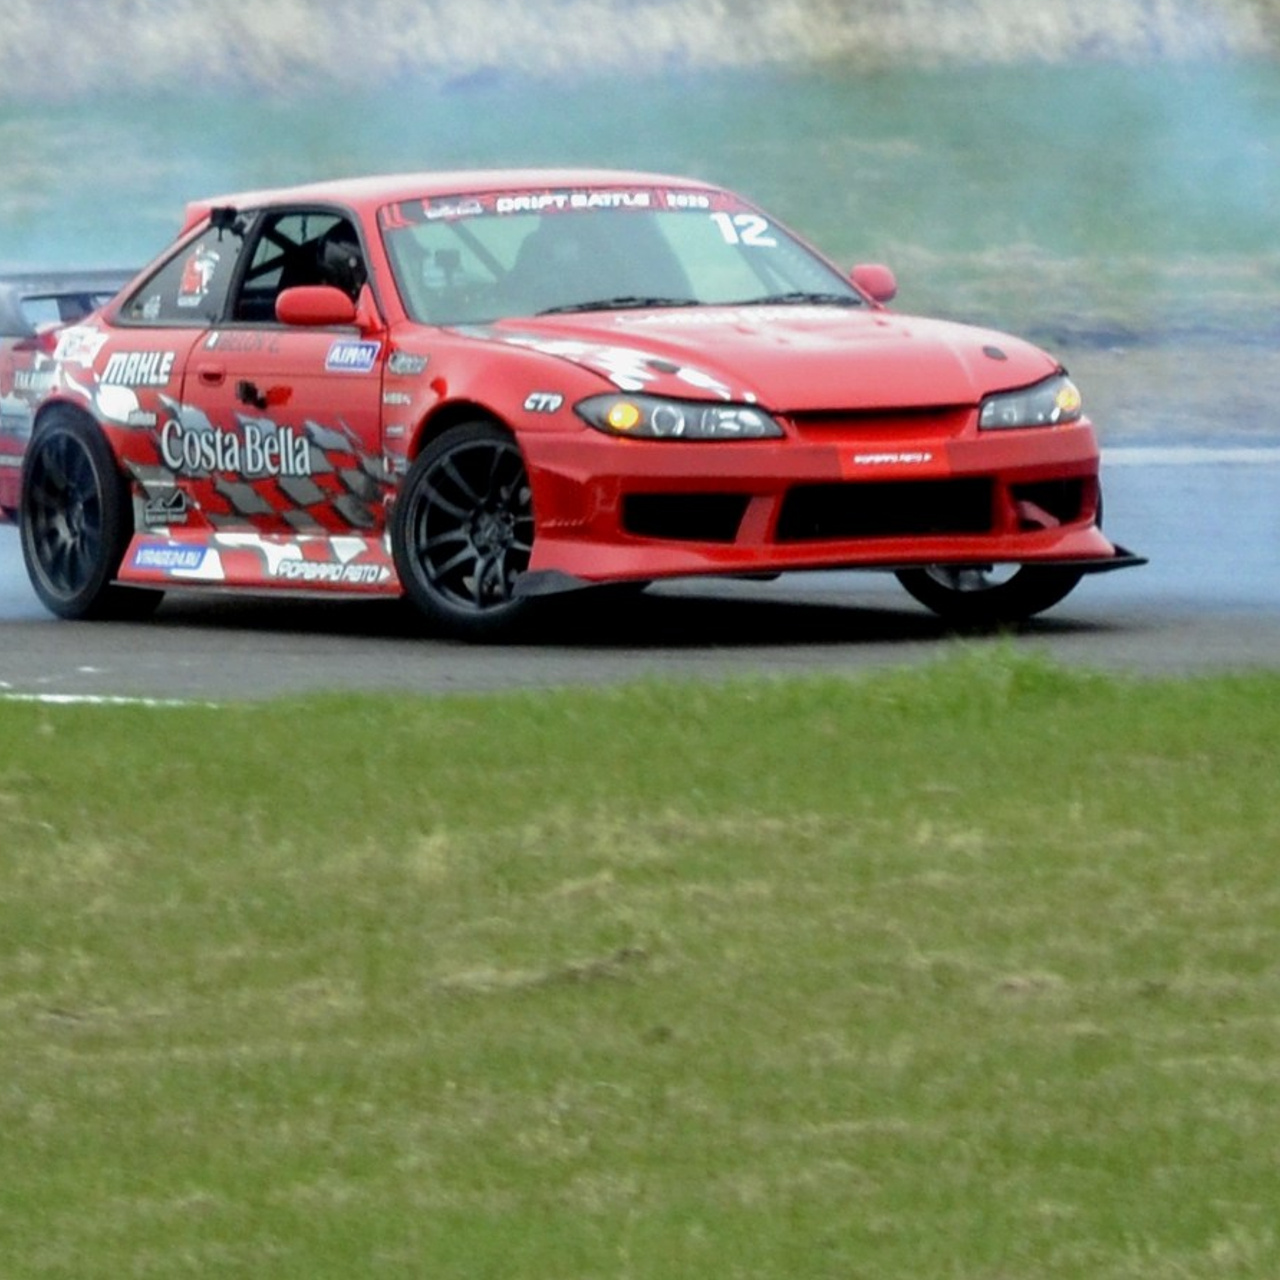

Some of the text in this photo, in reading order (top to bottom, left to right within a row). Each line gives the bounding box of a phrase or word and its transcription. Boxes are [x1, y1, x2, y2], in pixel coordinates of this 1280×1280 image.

[496, 194, 568, 212] DRIFT
[709, 211, 777, 248] 12
[101, 351, 175, 385] MAHLE
[161, 418, 311, 475] Costa Bella
